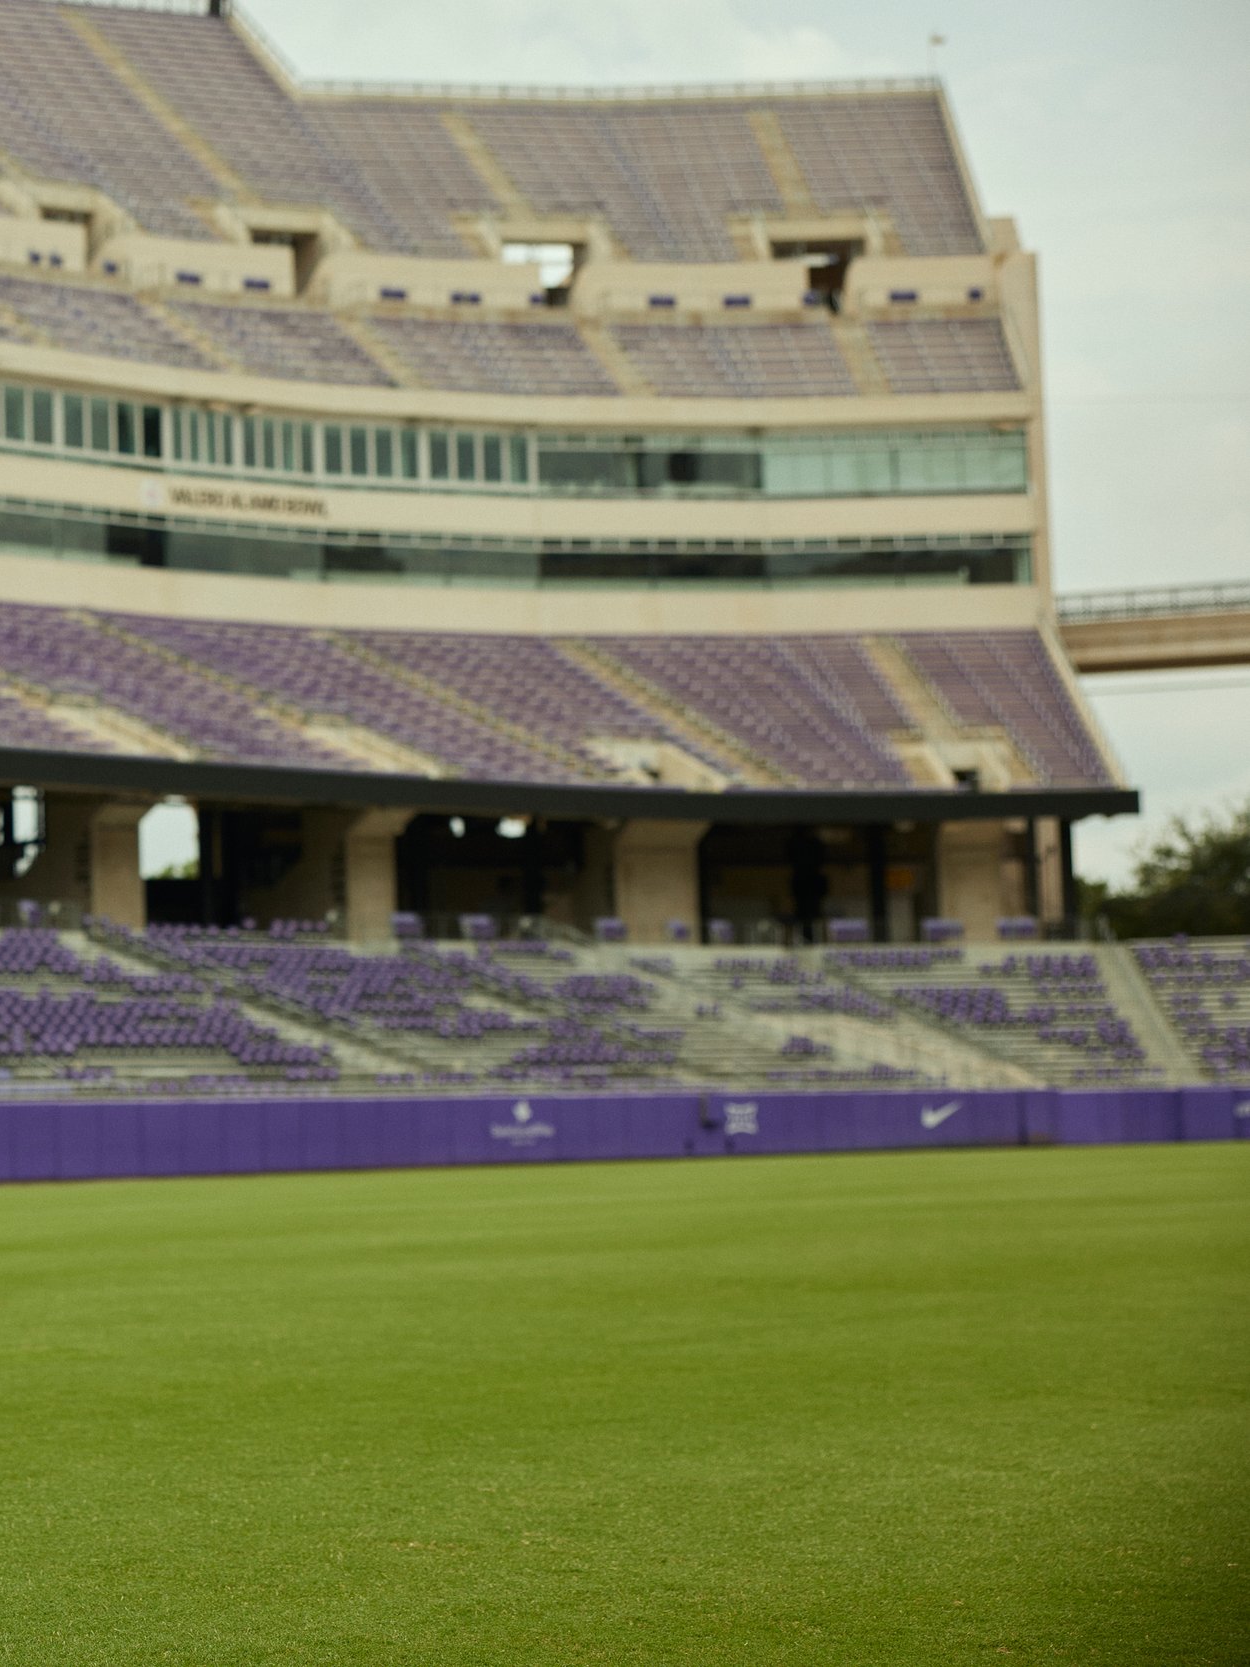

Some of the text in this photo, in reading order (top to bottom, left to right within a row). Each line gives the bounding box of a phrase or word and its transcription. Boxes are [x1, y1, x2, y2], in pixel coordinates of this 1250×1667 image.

[169, 487, 329, 519] VALERO ALAMO BOWL
